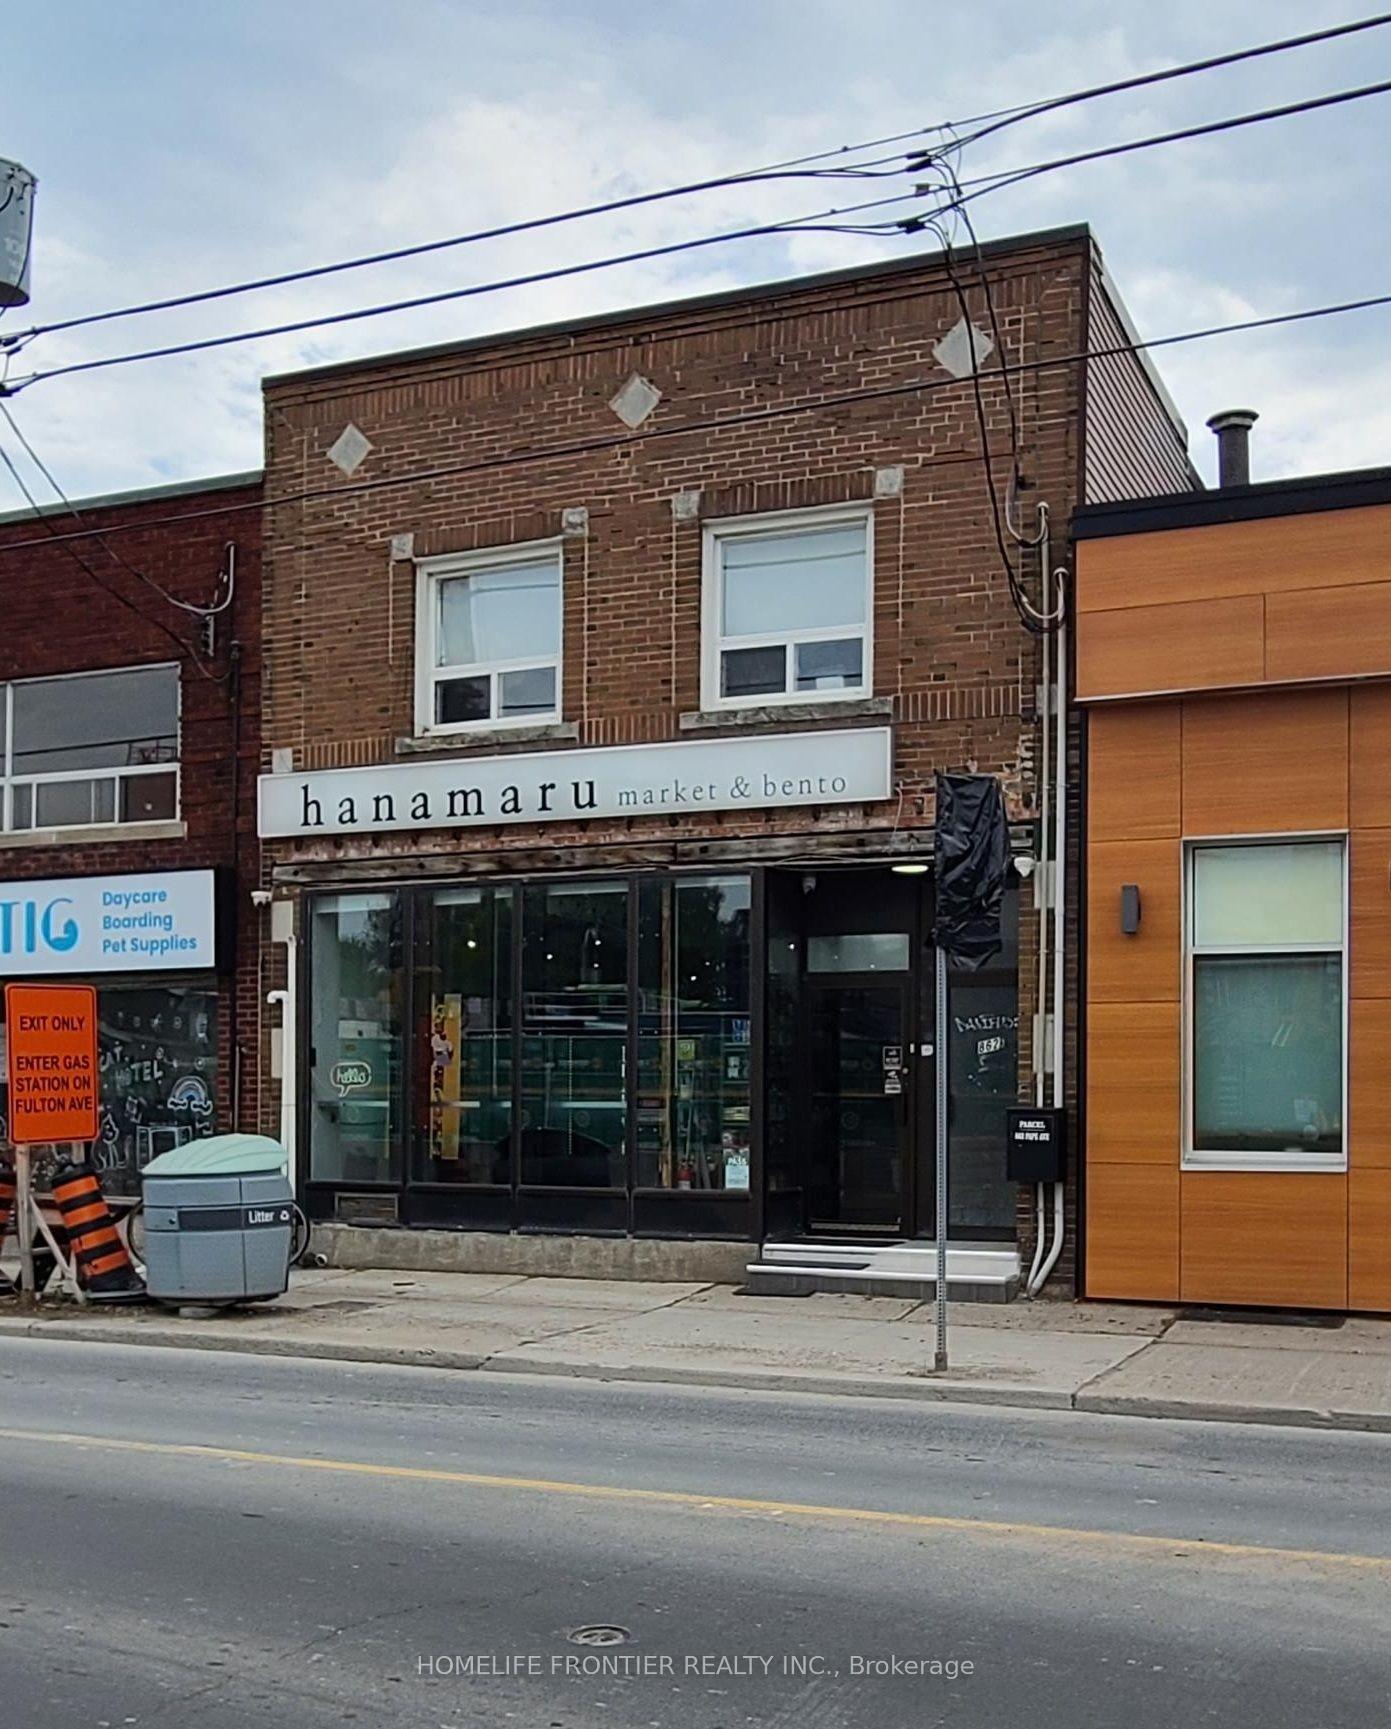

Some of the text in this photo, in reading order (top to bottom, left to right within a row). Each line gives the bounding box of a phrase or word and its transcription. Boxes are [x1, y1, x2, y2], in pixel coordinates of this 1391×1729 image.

[300, 773, 847, 827] hanamaru market & bento
[102, 890, 168, 909] Daycare
[102, 912, 173, 932] Boarding
[102, 935, 197, 956] Pet Supplies
[19, 1015, 85, 1031] EXIT ONLY
[16, 1055, 90, 1071] ENTER GAS
[15, 1076, 91, 1092] STATION ON
[15, 1096, 93, 1114] FULTON AVE
[248, 1210, 275, 1224] Litter
